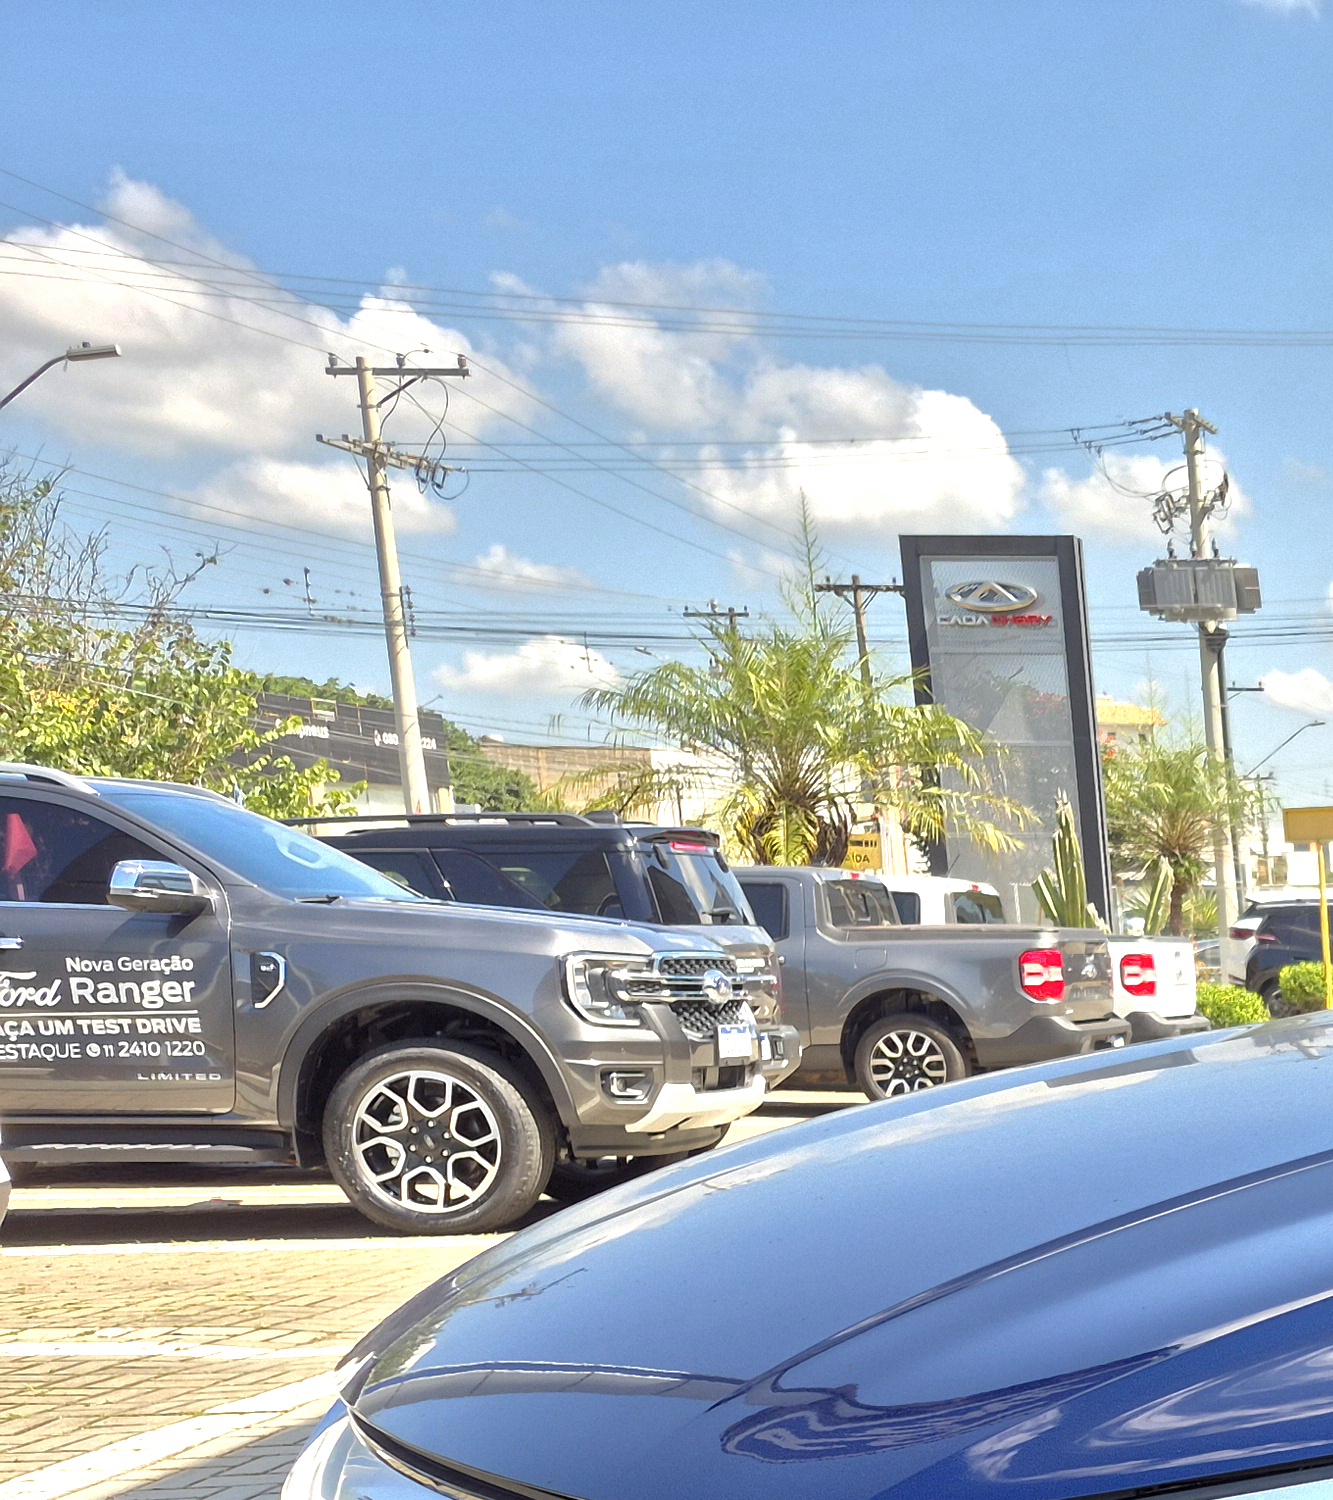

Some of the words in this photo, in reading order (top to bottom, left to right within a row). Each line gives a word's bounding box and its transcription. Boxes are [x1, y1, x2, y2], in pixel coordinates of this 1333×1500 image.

[65, 956, 114, 973] Nova
[117, 955, 194, 975] Geração
[69, 976, 196, 1009] Ranger
[38, 1020, 75, 1036] UM
[77, 1018, 132, 1036] TEST
[135, 1017, 202, 1034] DRIVE
[118, 1041, 161, 1057] 2410
[164, 1041, 206, 1057] 1220
[137, 1073, 222, 1081] LIMITED
